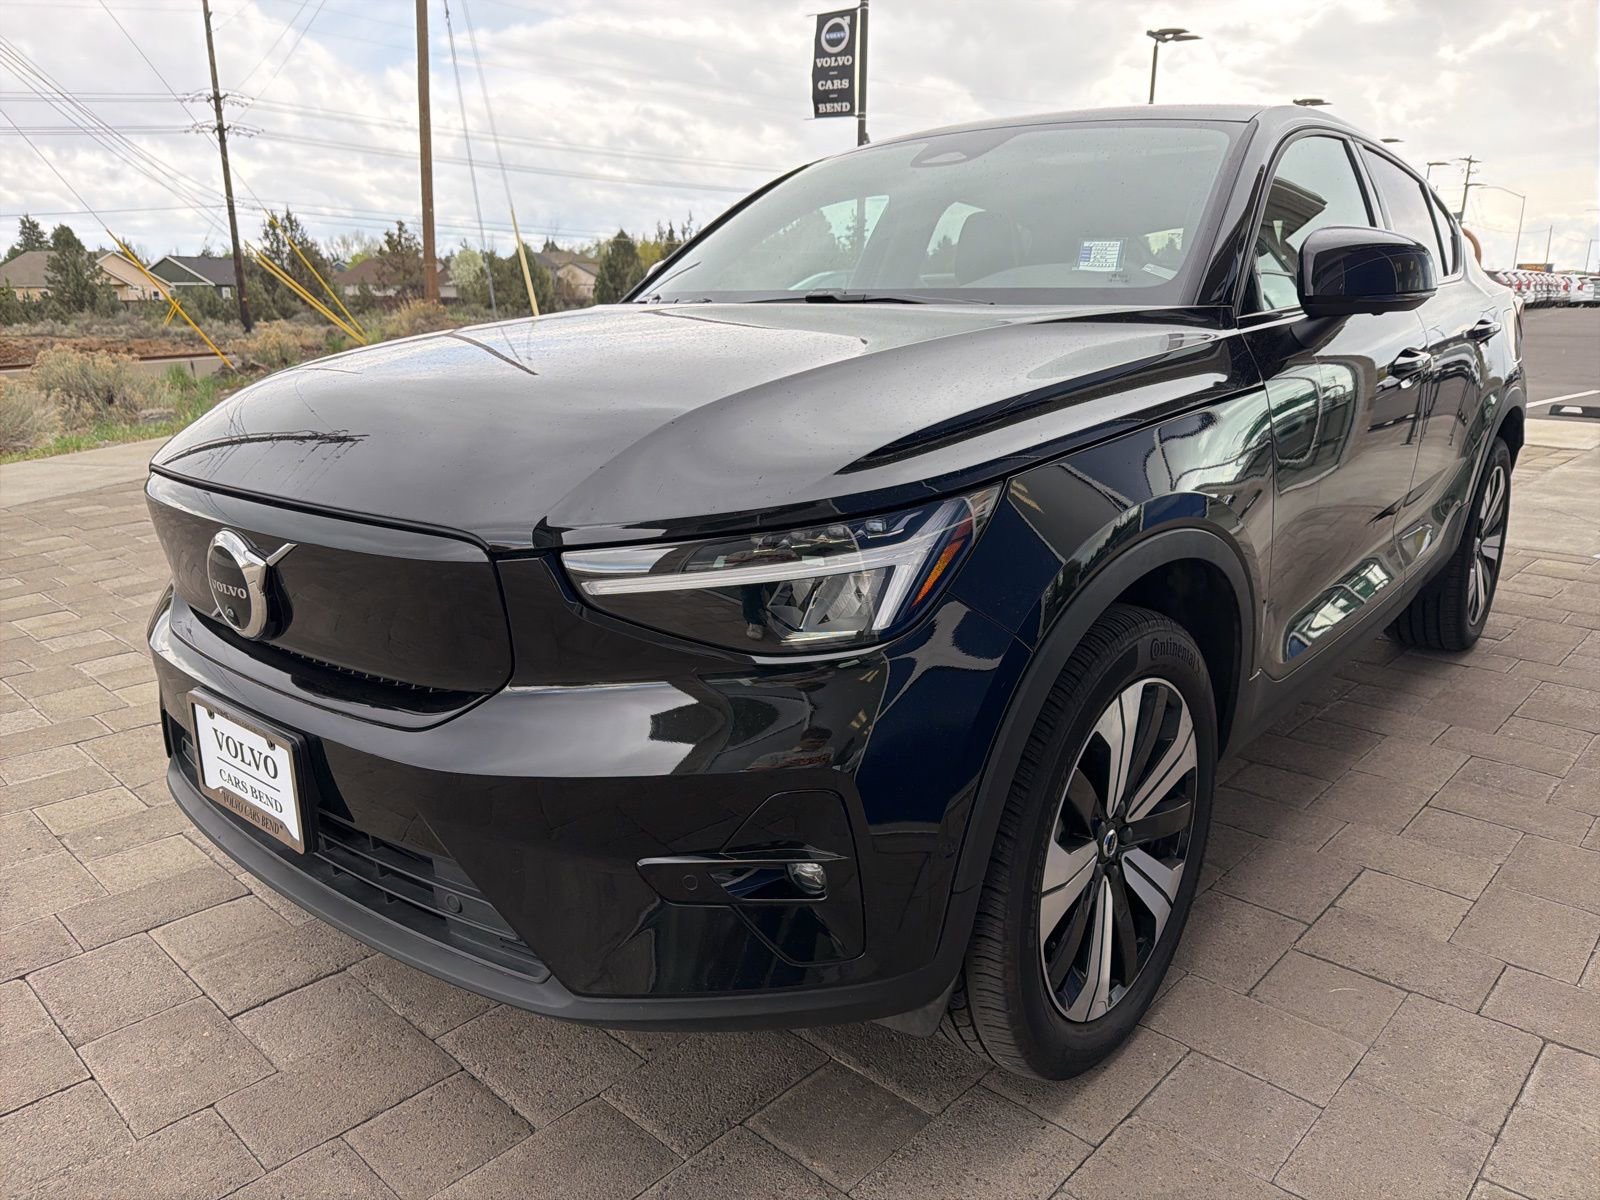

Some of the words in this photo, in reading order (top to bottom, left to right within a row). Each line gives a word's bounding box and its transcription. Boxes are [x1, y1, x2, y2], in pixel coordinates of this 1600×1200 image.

[816, 55, 853, 68] VOLVO
[818, 79, 850, 91] CARS
[818, 102, 851, 113] BEND
[211, 579, 247, 599] VOLVO
[212, 727, 278, 780] VOLVO
[219, 768, 248, 794] CARS
[250, 785, 283, 814] BEND
[222, 791, 244, 813] VOLVO
[244, 805, 260, 823] CARS
[261, 815, 280, 835] BEND
